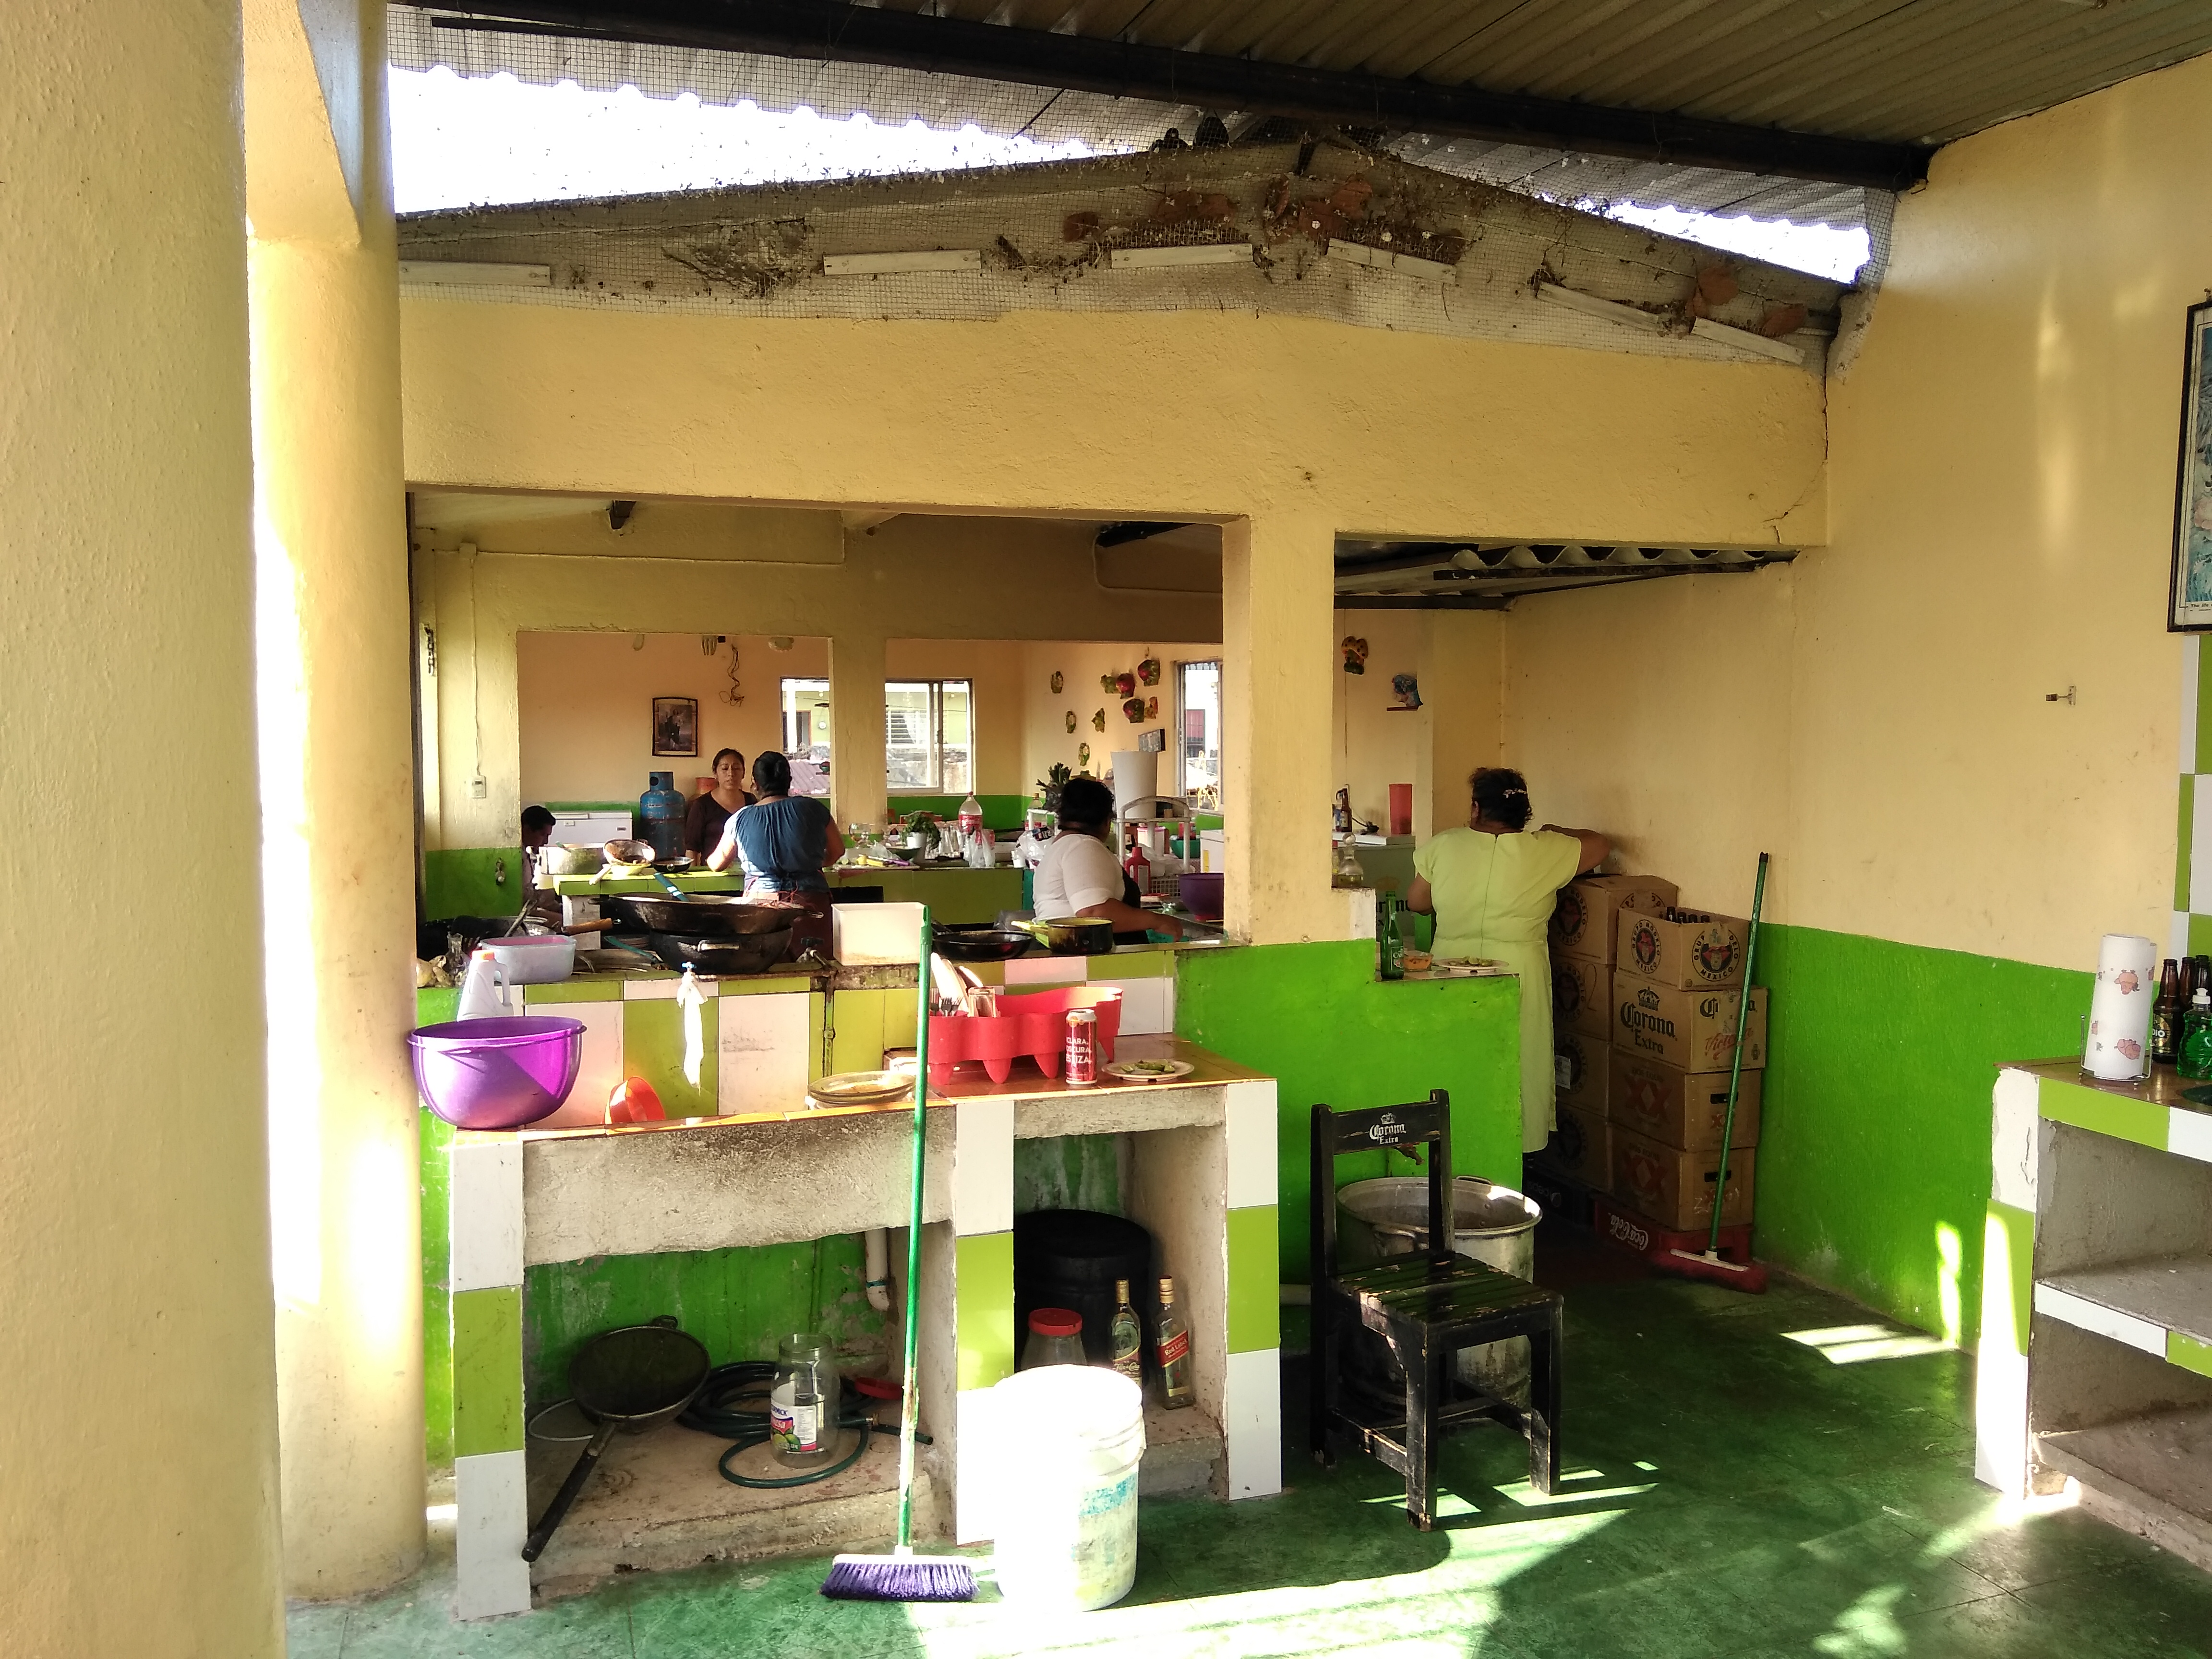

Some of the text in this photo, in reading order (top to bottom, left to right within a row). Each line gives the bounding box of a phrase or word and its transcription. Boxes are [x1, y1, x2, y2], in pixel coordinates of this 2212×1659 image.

[1632, 923, 1660, 956] GRUPO MODELO
[1694, 935, 1705, 960] GRUP
[1700, 966, 1733, 980] MEXICO
[1620, 1001, 1675, 1038] Corona
[2152, 1028, 2165, 1037] DIO
[1635, 1030, 1664, 1055] Extra
[1369, 1124, 1407, 1141] Corona
[1379, 1136, 1399, 1145] Extra
[1164, 1347, 1175, 1356] Red
